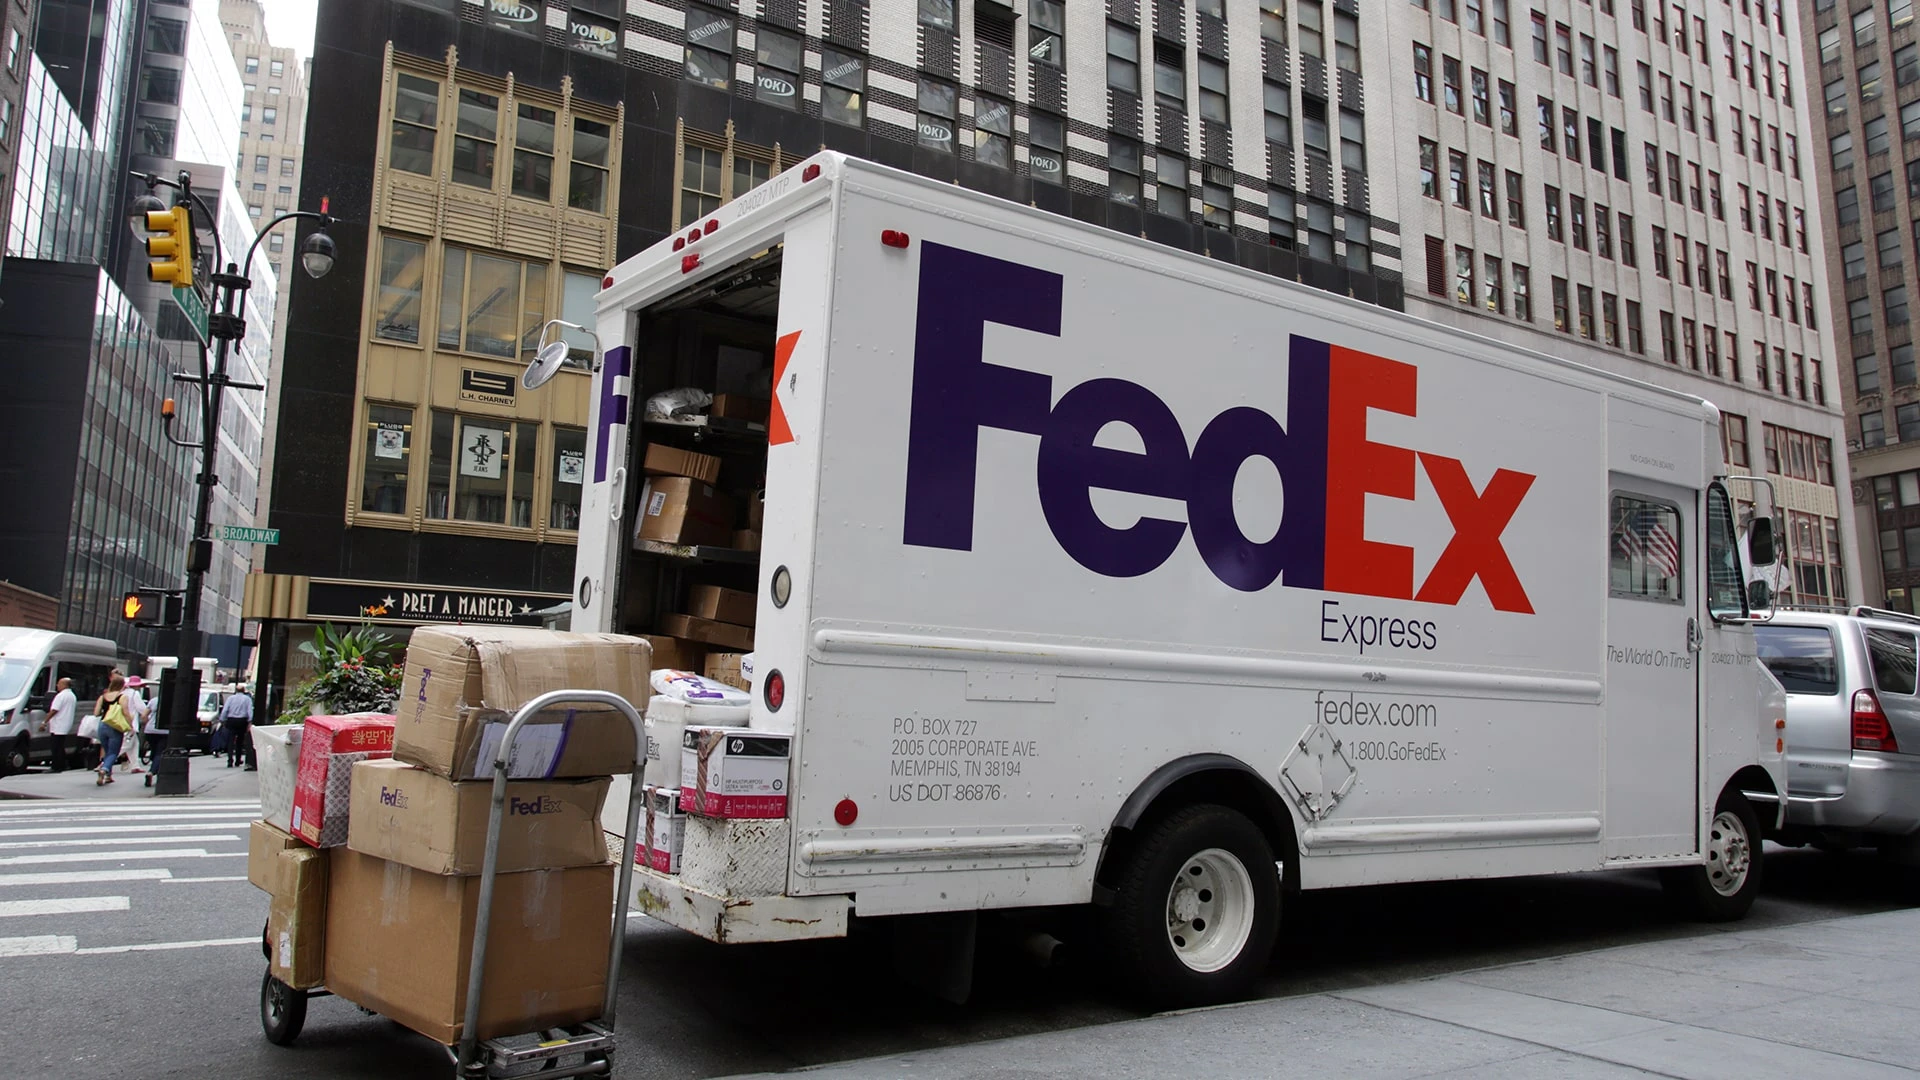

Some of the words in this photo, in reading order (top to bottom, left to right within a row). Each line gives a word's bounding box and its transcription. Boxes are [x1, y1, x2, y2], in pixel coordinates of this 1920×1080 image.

[489, 0, 525, 19] YOKI
[689, 18, 731, 42] SENSATIONAL
[823, 59, 862, 81] SENSATIONAL
[757, 76, 786, 93] YOKI
[918, 123, 943, 139] YOKI
[1030, 155, 1053, 170] YOKI
[737, 189, 767, 217] 204027
[770, 176, 790, 199] MTP
[478, 394, 514, 405] CHARNEY
[903, 239, 1537, 616] FedEx
[223, 527, 277, 542] BROADWAY
[402, 592, 436, 613] PRET
[442, 595, 451, 614] A
[458, 595, 513, 617] MANGER
[1321, 600, 1437, 655] Express
[1606, 645, 1623, 663] The
[1625, 647, 1652, 665] World
[1654, 650, 1668, 667] On
[1669, 652, 1691, 669] Time
[1711, 652, 1735, 665] 204027
[1736, 654, 1752, 667] MTP
[414, 668, 432, 724] FedEx
[1315, 691, 1437, 727] fedex.com
[893, 718, 917, 735] P.O.
[922, 718, 951, 735] BOX
[955, 720, 978, 736] 727
[732, 739, 744, 753] hp
[891, 739, 925, 755] 2005
[928, 739, 1009, 756] CORPORATE
[1012, 741, 1040, 757] AVE.
[1349, 741, 1447, 761] 1.800.GoFedEx
[890, 760, 961, 778] MEMPHIS,
[964, 761, 982, 776] TN
[984, 761, 1021, 777] 38194
[380, 786, 409, 809] FedEx
[889, 784, 912, 802] US
[917, 784, 952, 801] DOT
[955, 784, 1001, 801] 86876
[510, 795, 562, 815] FedEx
